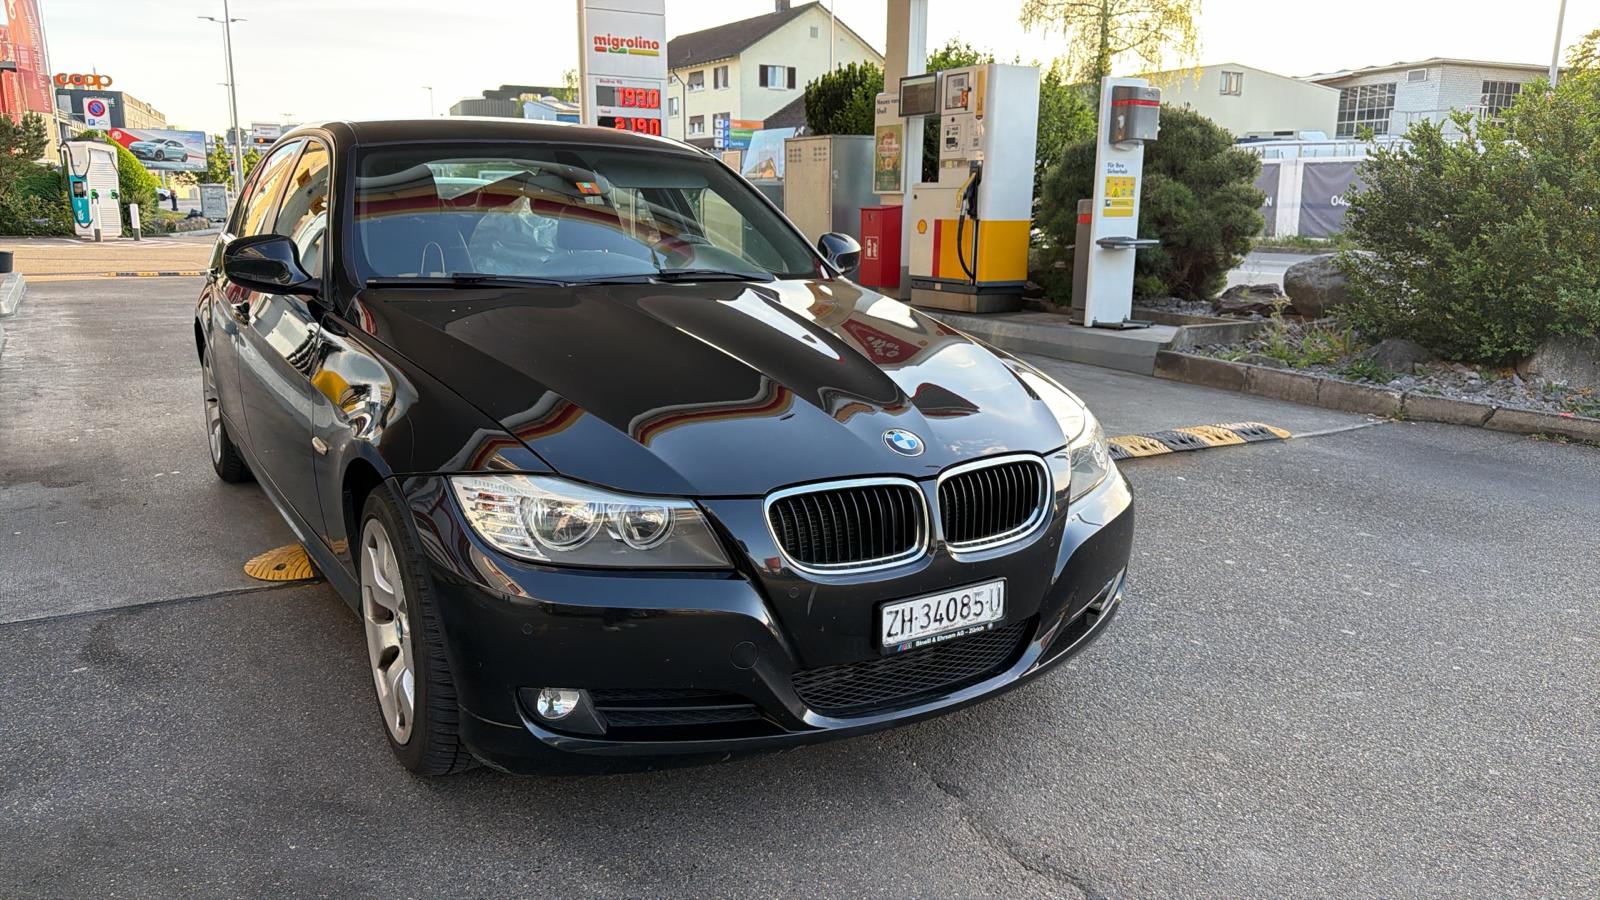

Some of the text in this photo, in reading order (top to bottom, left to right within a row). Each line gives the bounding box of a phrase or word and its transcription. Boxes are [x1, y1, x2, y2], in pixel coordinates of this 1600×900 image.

[593, 34, 660, 50] migrolino
[55, 73, 112, 89] coop
[969, 625, 985, 634] Zürich
